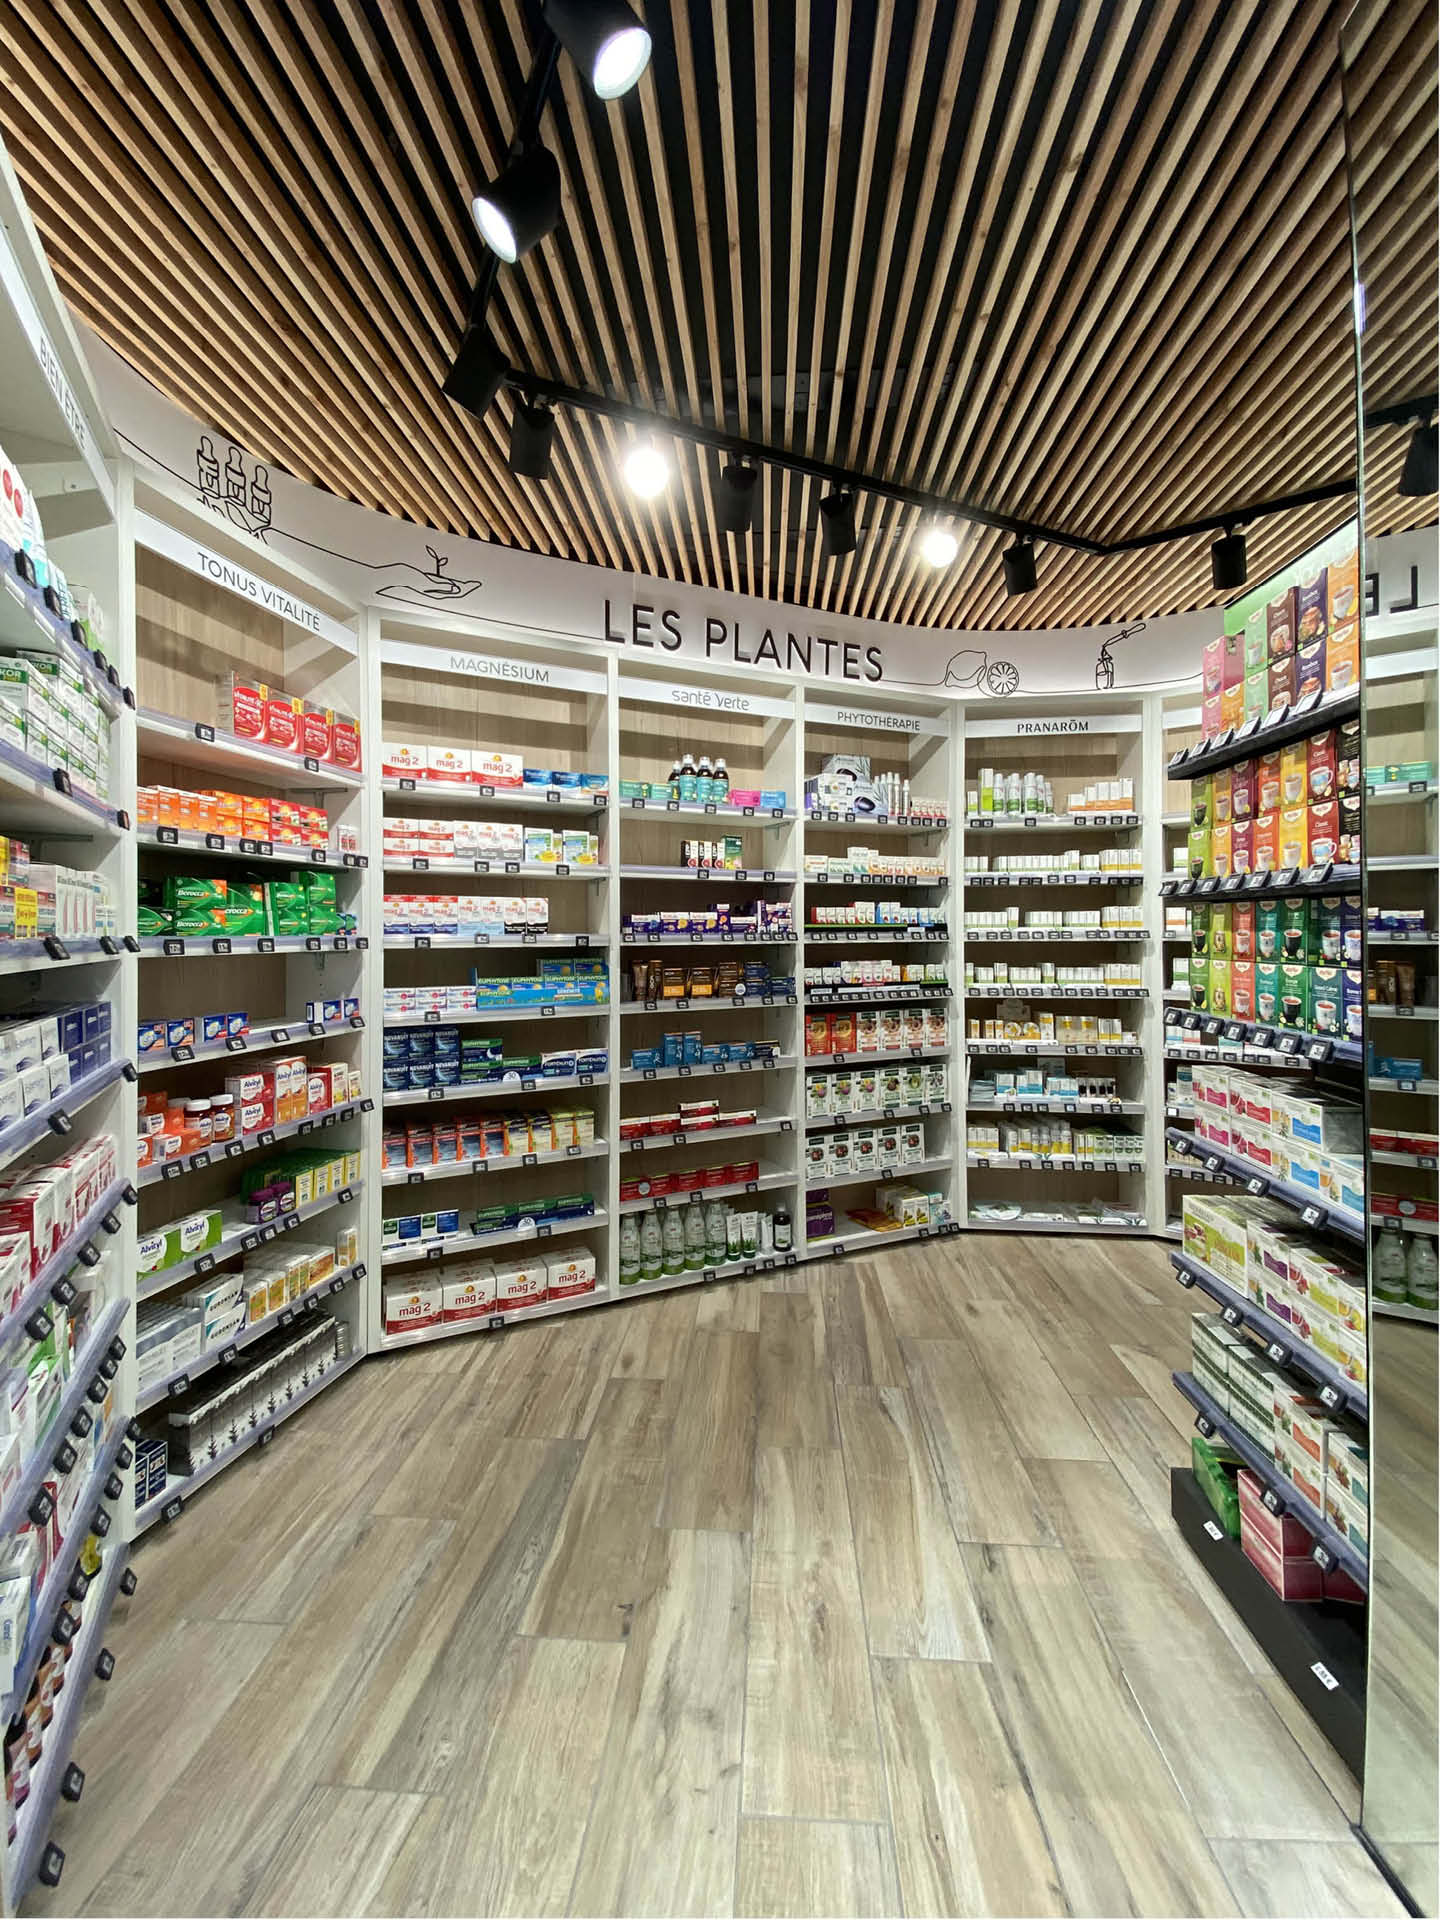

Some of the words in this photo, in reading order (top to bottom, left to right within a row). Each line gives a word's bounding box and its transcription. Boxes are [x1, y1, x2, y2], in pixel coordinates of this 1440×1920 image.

[198, 552, 257, 597] TONUS
[261, 585, 320, 632] VITALITÉ
[604, 600, 683, 652] LES
[705, 618, 883, 682] PLANTES
[450, 656, 549, 682] MAGNÉSIUM
[672, 690, 711, 706] santé
[391, 756, 411, 766] mag
[412, 757, 419, 765] 2
[436, 759, 456, 769] mag
[456, 760, 463, 768] 2
[483, 762, 504, 772] mag
[505, 764, 512, 772] 2
[244, 1079, 262, 1089] Alvityl
[245, 1107, 262, 1116] Alvityl
[185, 1221, 205, 1235] Alvityl
[140, 1239, 162, 1254] Alvityl
[559, 1273, 578, 1283] mag
[579, 1271, 585, 1279] 2
[508, 1284, 529, 1294] mag
[529, 1281, 537, 1290] 2
[455, 1295, 477, 1305] mag
[478, 1292, 485, 1301] 2
[399, 1305, 422, 1316] mag
[423, 1303, 431, 1312] 2
